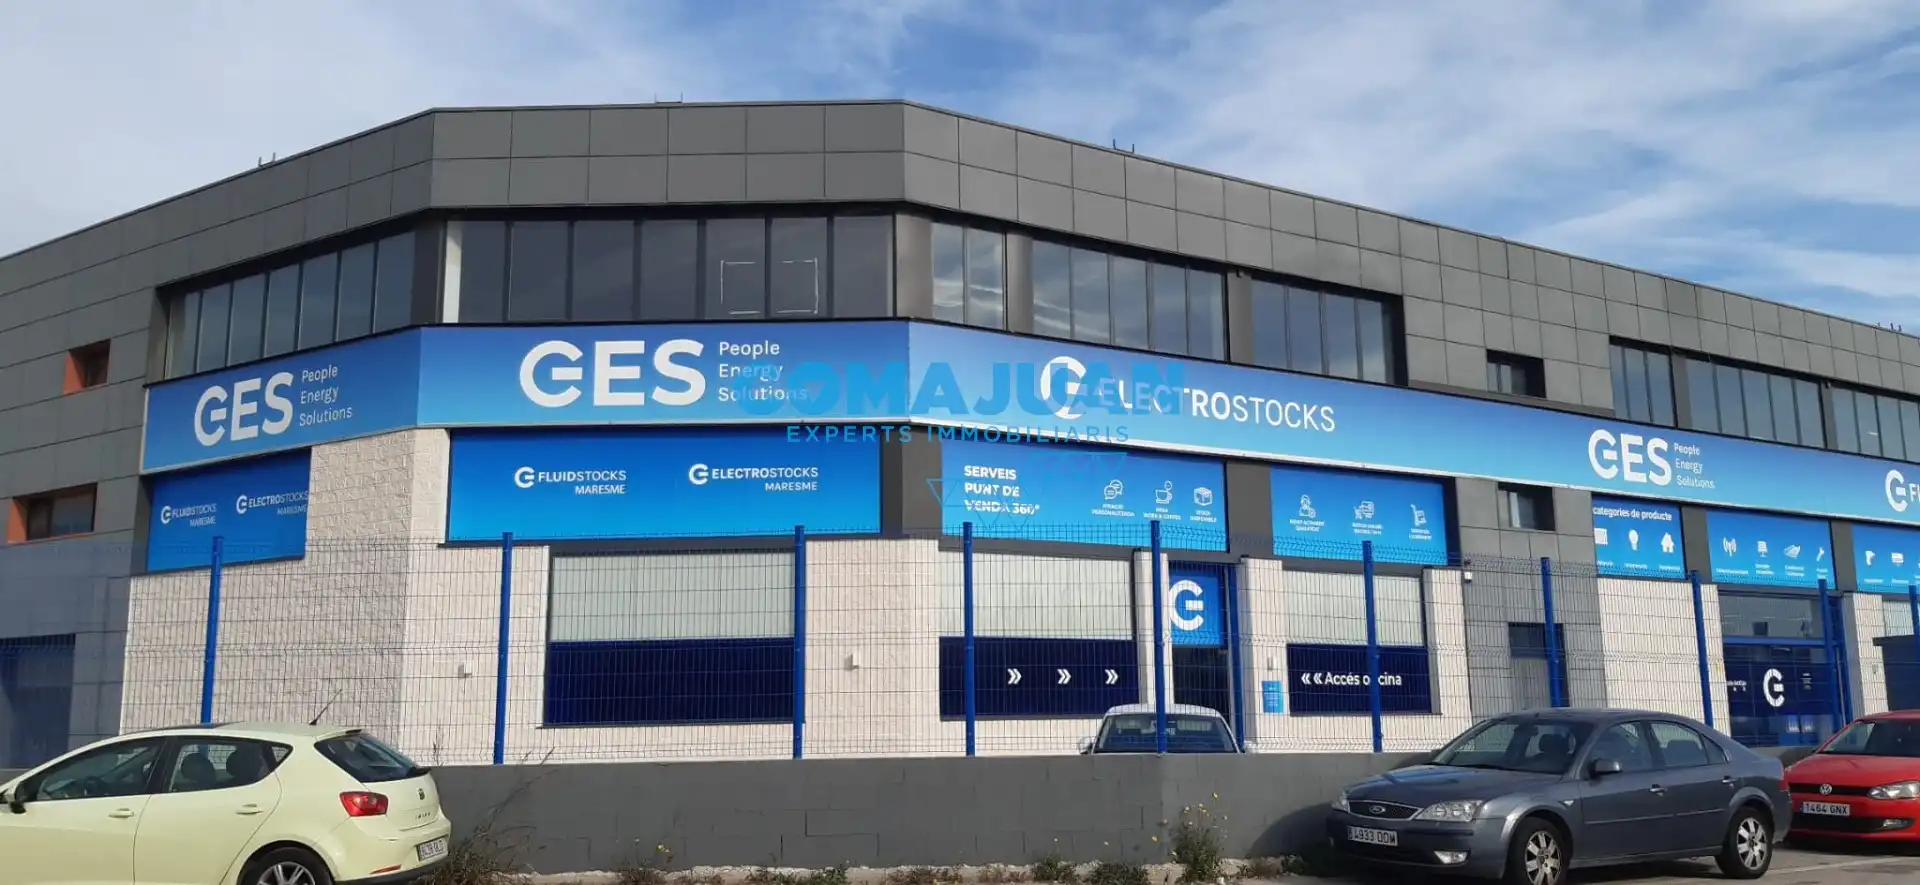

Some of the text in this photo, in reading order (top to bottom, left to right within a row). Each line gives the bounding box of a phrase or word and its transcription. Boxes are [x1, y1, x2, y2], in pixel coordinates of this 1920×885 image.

[719, 340, 780, 360] People
[302, 364, 338, 382] People
[520, 339, 706, 407] GES
[719, 363, 783, 381] Energy
[300, 385, 339, 405] Energy
[718, 386, 807, 402] Solutions
[194, 372, 294, 446] GES
[1100, 377, 1336, 432] ELECTROSTOCKS
[299, 406, 353, 426] Solutions
[1673, 442, 1700, 456] People
[1588, 429, 1672, 486] GES
[712, 467, 818, 480] ELECTROSTOCKS
[964, 465, 1017, 480] SERVEIS
[1676, 458, 1703, 474] Energy
[538, 470, 627, 483] FLUIDSTOCKS
[1676, 474, 1716, 489] Solutions
[575, 484, 626, 495] MARESME
[764, 482, 818, 492] MARESME
[964, 482, 1020, 497] PUNT DE
[964, 500, 1010, 513] VENDA
[1592, 506, 1672, 521] categories de producte
[1362, 672, 1402, 686] ocina
